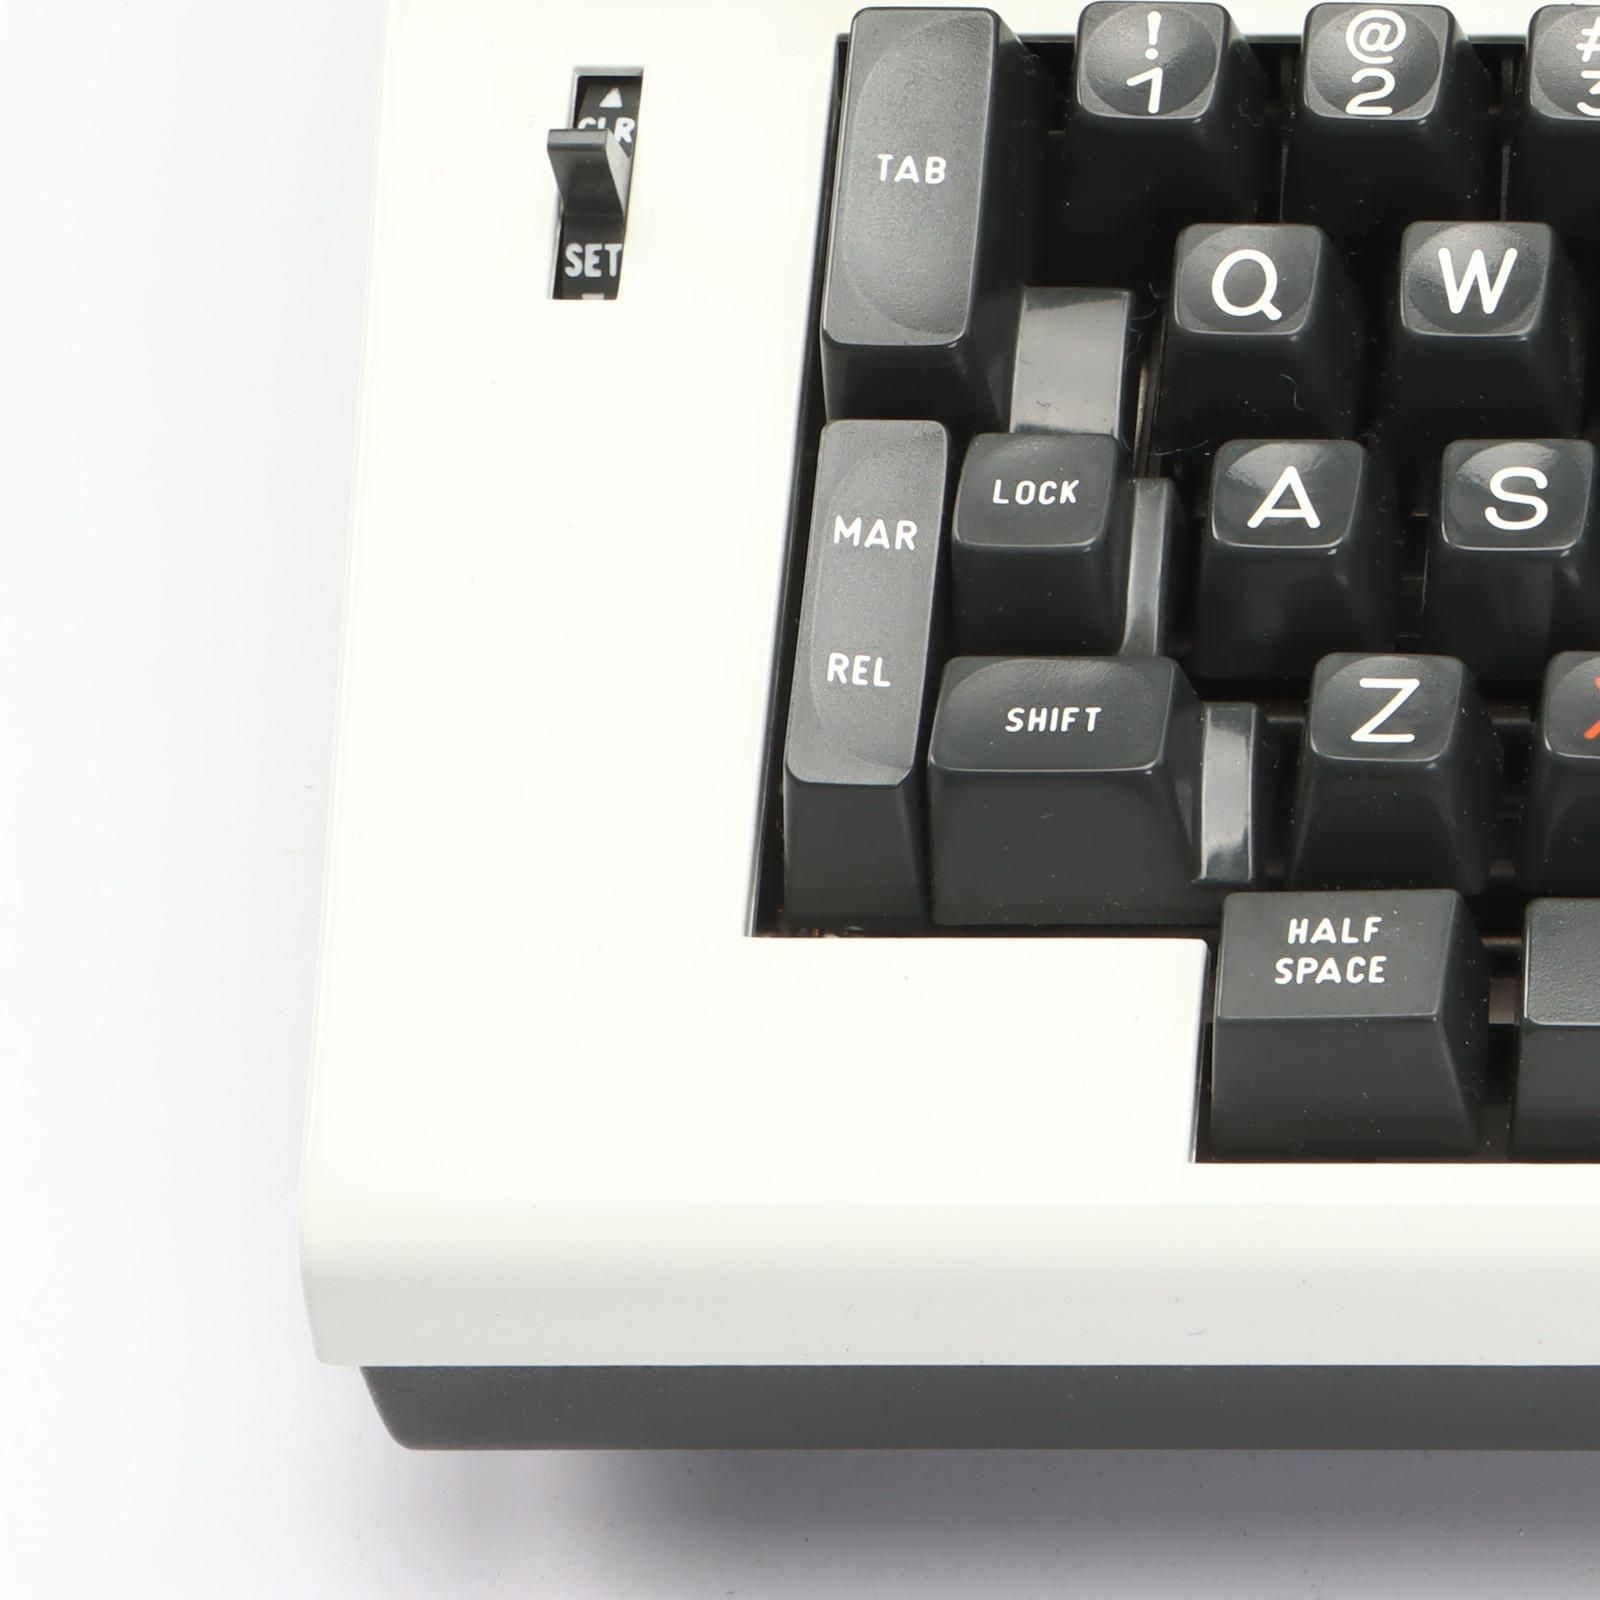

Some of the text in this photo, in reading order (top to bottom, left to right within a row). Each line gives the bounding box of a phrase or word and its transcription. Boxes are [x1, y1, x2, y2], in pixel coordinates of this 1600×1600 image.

[1145, 11, 1162, 60] !
[1345, 9, 1406, 65] @
[1126, 67, 1163, 114] 1
[1345, 67, 1395, 115] 2
[877, 153, 947, 184] TAB
[564, 243, 622, 278] SET
[1438, 247, 1518, 314] W
[1211, 249, 1282, 321] Q
[993, 479, 1079, 505] LOCK
[1247, 465, 1320, 528] A
[1485, 466, 1548, 530] S
[833, 515, 918, 551] MAR
[827, 652, 891, 687] REL
[1005, 707, 1102, 732] SHIFT
[1351, 678, 1420, 743] Z
[1288, 916, 1382, 944] HALF
[1275, 956, 1387, 984] SPACE
